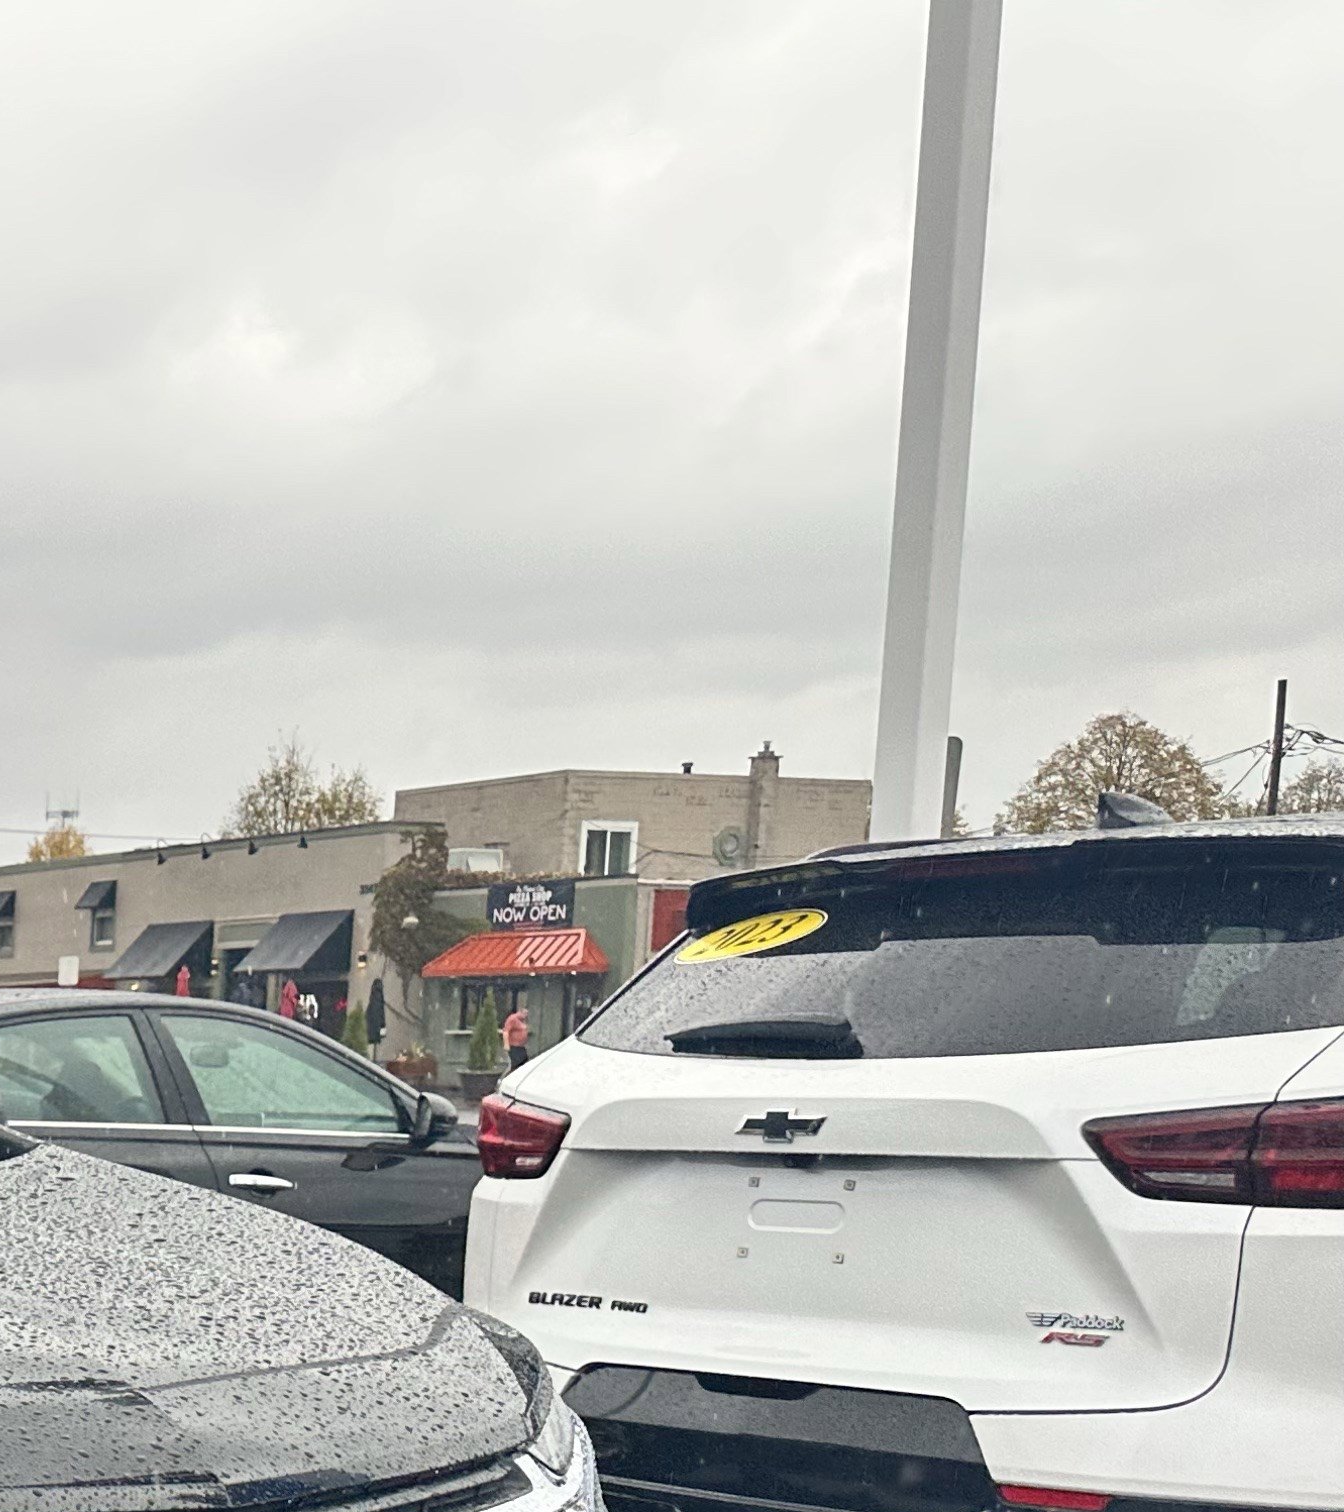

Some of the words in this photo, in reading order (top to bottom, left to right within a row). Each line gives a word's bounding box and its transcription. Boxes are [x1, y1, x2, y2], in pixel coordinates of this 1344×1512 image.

[493, 906, 526, 923] NOW
[529, 904, 566, 921] OPEN
[690, 914, 810, 957] 2023
[528, 1291, 602, 1309] BLAZER
[611, 1300, 648, 1314] AWD
[1060, 1312, 1125, 1331] Paddock
[1040, 1331, 1110, 1347] RS
